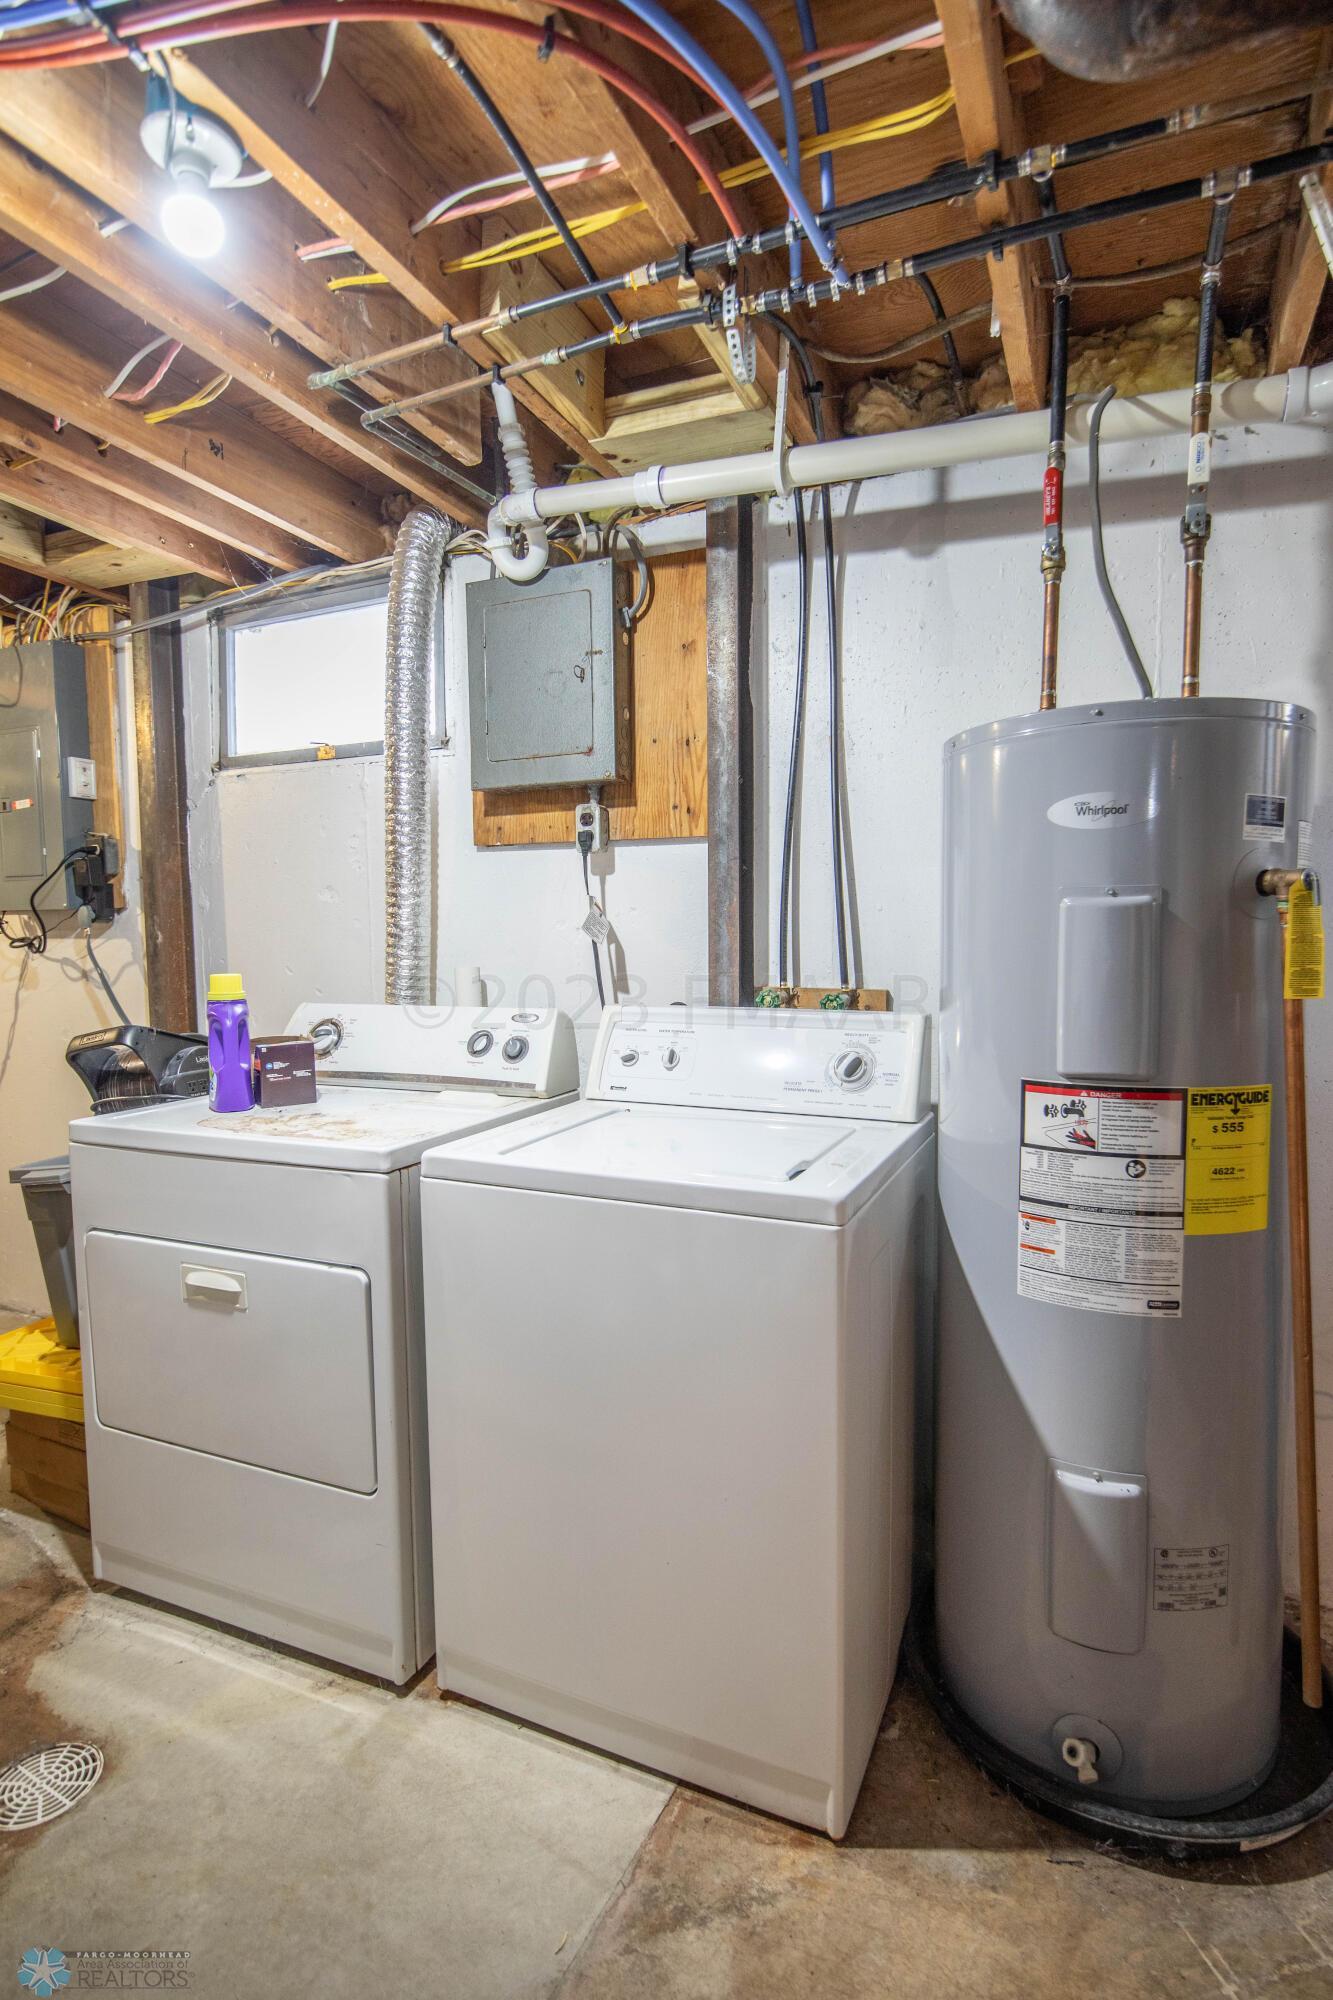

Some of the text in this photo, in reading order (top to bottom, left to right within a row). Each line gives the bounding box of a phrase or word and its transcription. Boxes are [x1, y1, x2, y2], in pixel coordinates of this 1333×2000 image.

[1075, 804, 1130, 818] Whirlpool
[1212, 1122, 1244, 1133] $ 555
[1212, 1167, 1235, 1175] 4622
